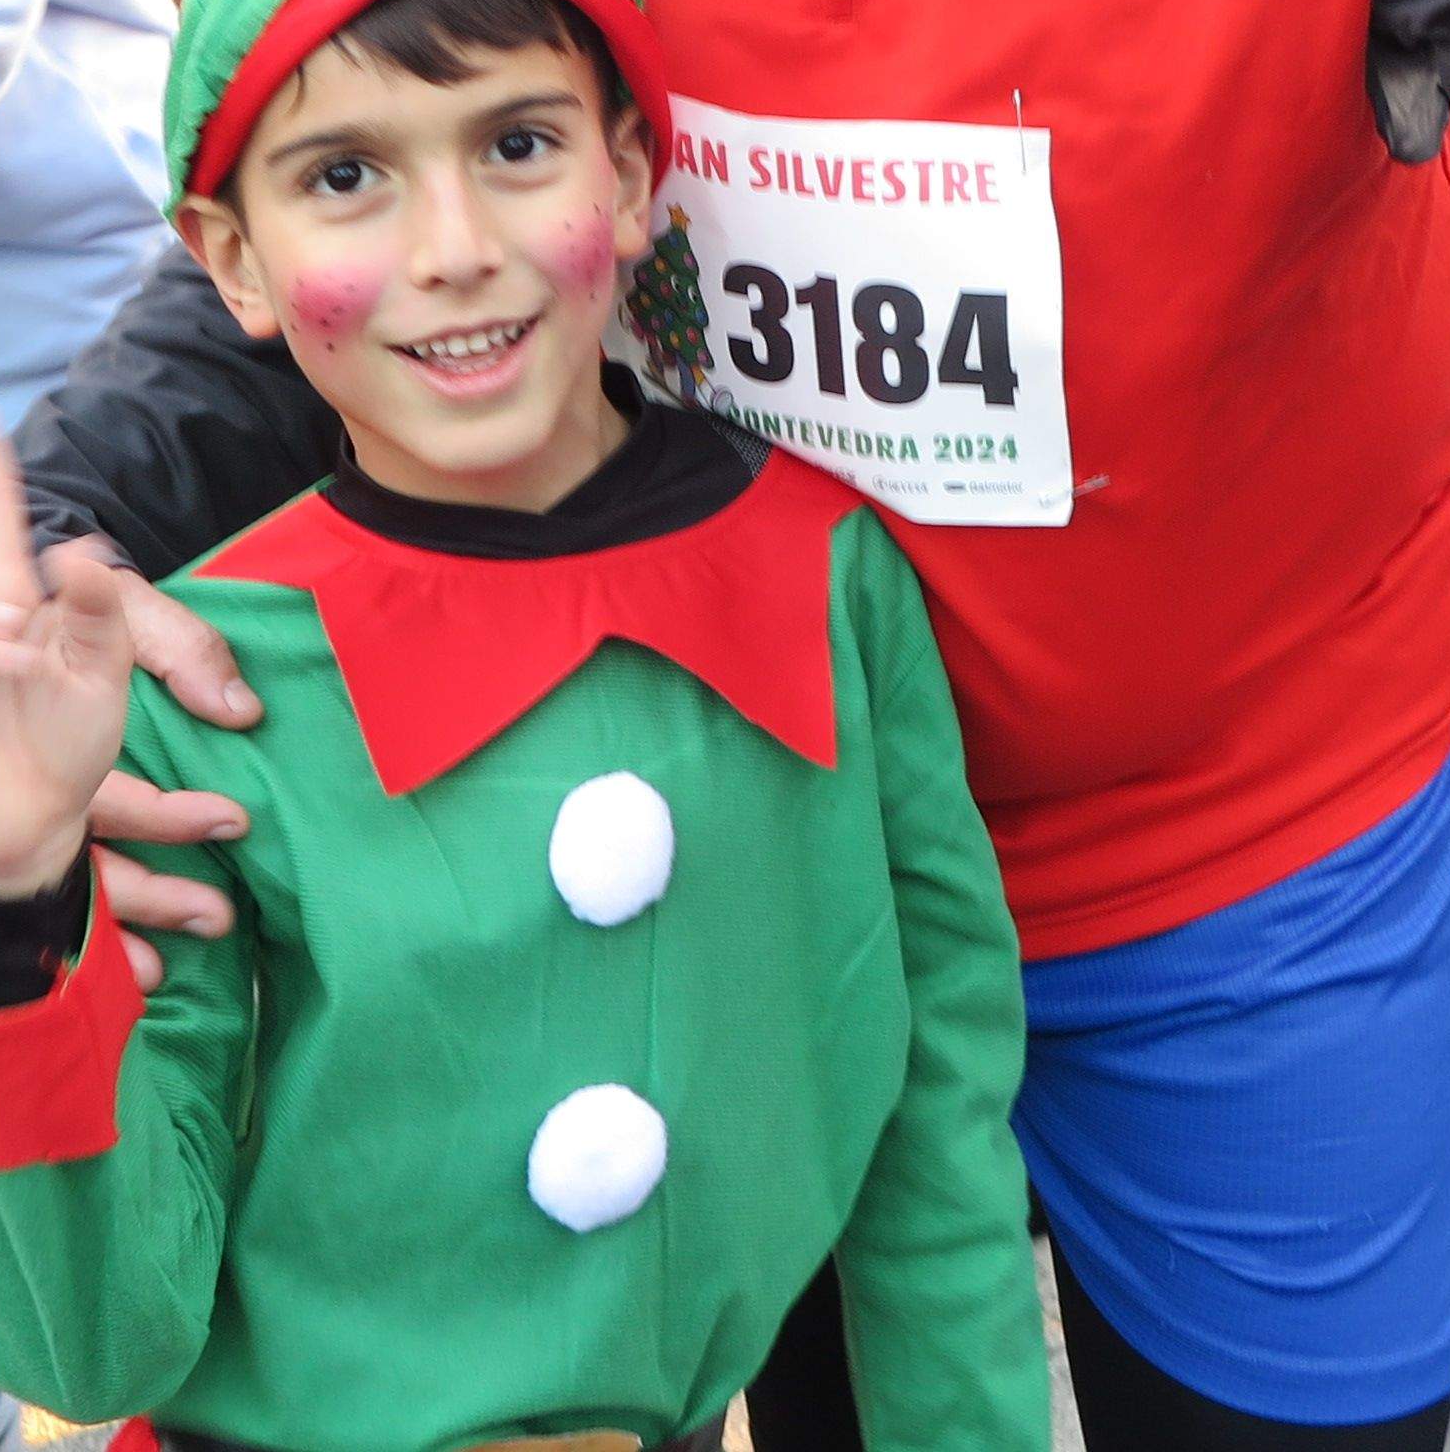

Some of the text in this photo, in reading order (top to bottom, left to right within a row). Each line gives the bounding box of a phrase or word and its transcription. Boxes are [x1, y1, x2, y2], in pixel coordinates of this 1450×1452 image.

[673, 127, 1001, 206] AN SILVESTRE
[720, 260, 1019, 409] 3184
[932, 431, 1020, 465] 2024
